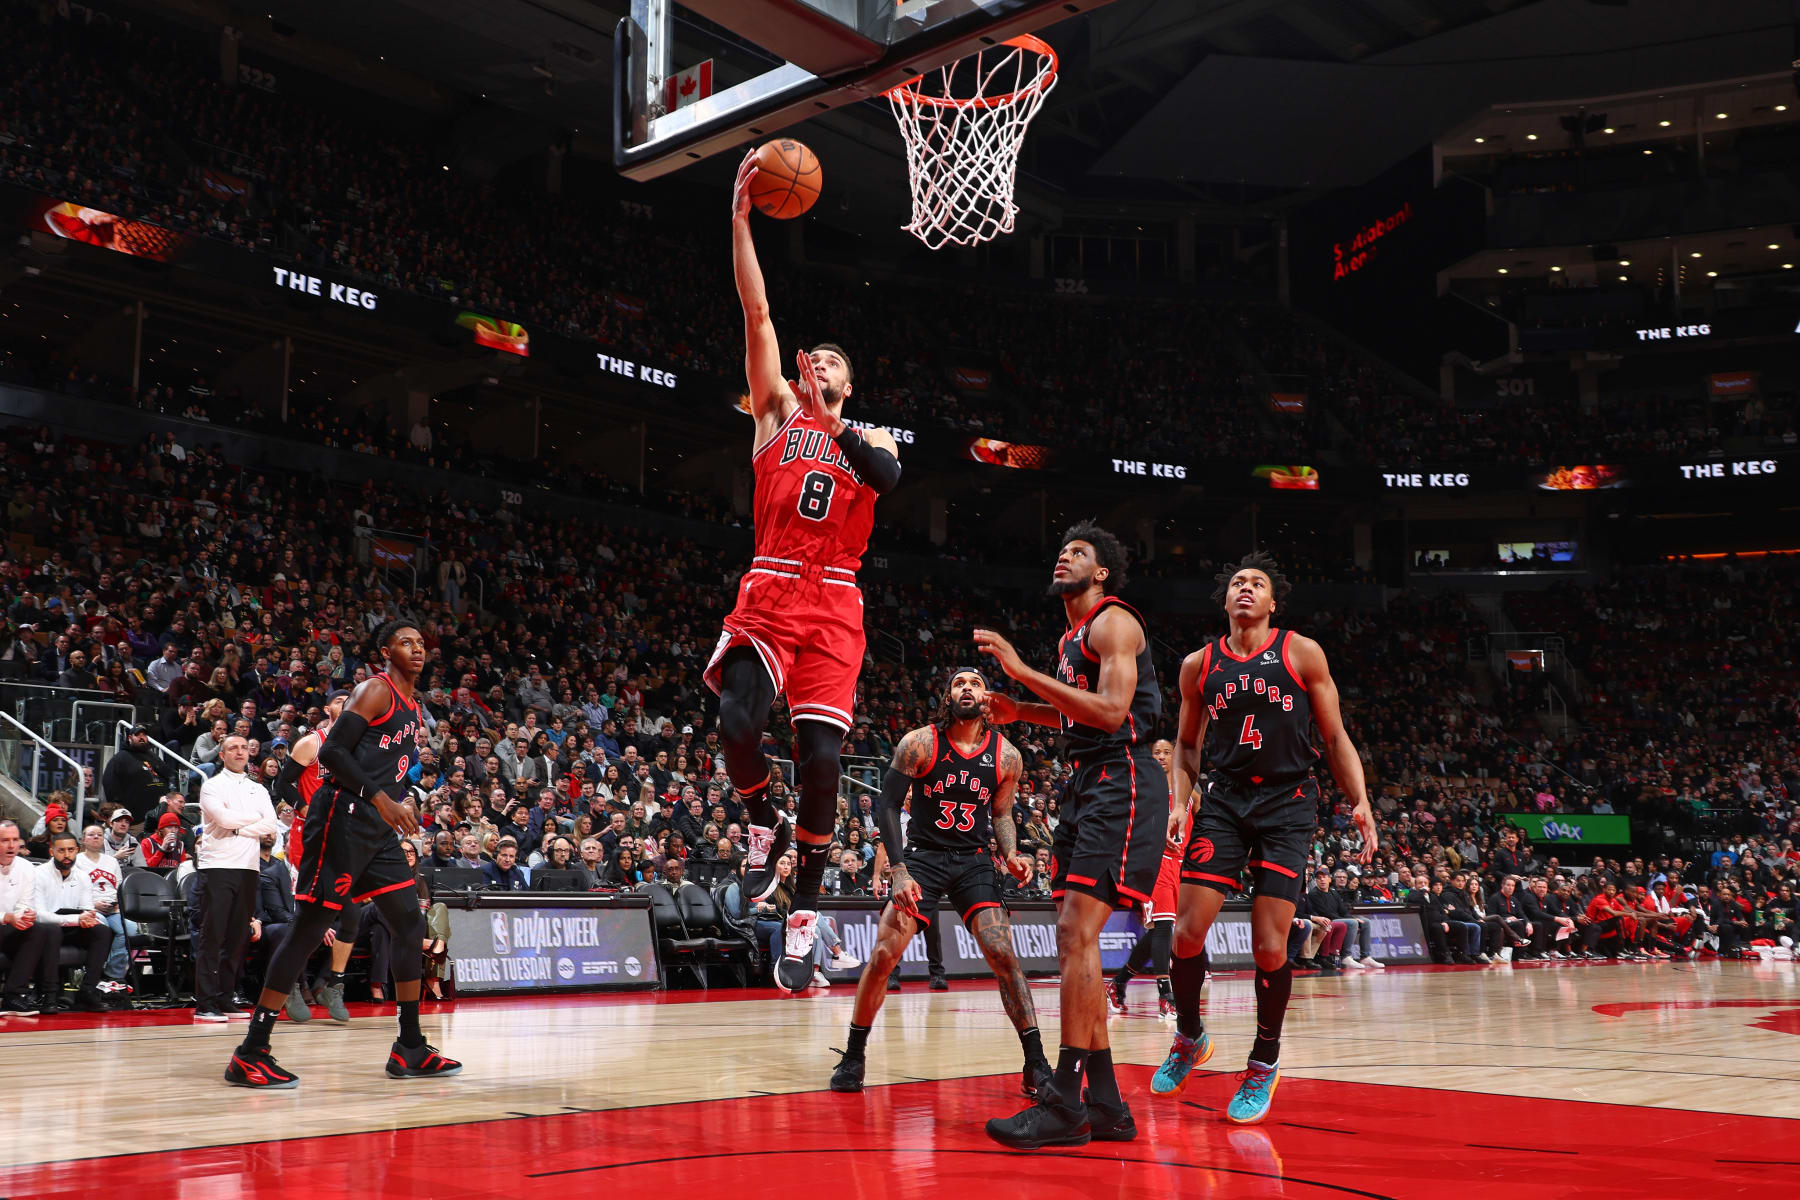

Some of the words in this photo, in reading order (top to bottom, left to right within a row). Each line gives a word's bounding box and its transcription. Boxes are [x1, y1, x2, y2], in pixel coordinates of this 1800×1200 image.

[273, 266, 322, 297] THE
[330, 282, 377, 310] KEG
[1054, 278, 1089, 294] 324
[1636, 328, 1671, 341] THE
[1676, 324, 1711, 337] KEG
[597, 353, 635, 379] THE
[640, 364, 676, 389] KEG
[1496, 378, 1537, 397] 301
[1112, 459, 1147, 476] THE
[1152, 462, 1187, 480] KEG
[1382, 473, 1423, 487] THE
[1429, 472, 1470, 487] KEG
[1680, 463, 1725, 479] THE
[1732, 459, 1777, 476] KEG
[500, 490, 523, 505] 120
[797, 469, 836, 522] 8
[1208, 673, 1293, 720] RAPTORS
[1239, 713, 1263, 750] 4
[396, 754, 410, 783] 9
[934, 799, 977, 832] 33
[1543, 821, 1583, 841] MAX
[513, 911, 562, 954] RIVALS
[562, 917, 600, 947] WEEK
[1010, 924, 1058, 958] TUESDA
[1099, 931, 1137, 950] ESPN
[455, 958, 500, 982] BEGINS
[501, 956, 552, 981] TUESDAY
[582, 961, 618, 974] ESPN
